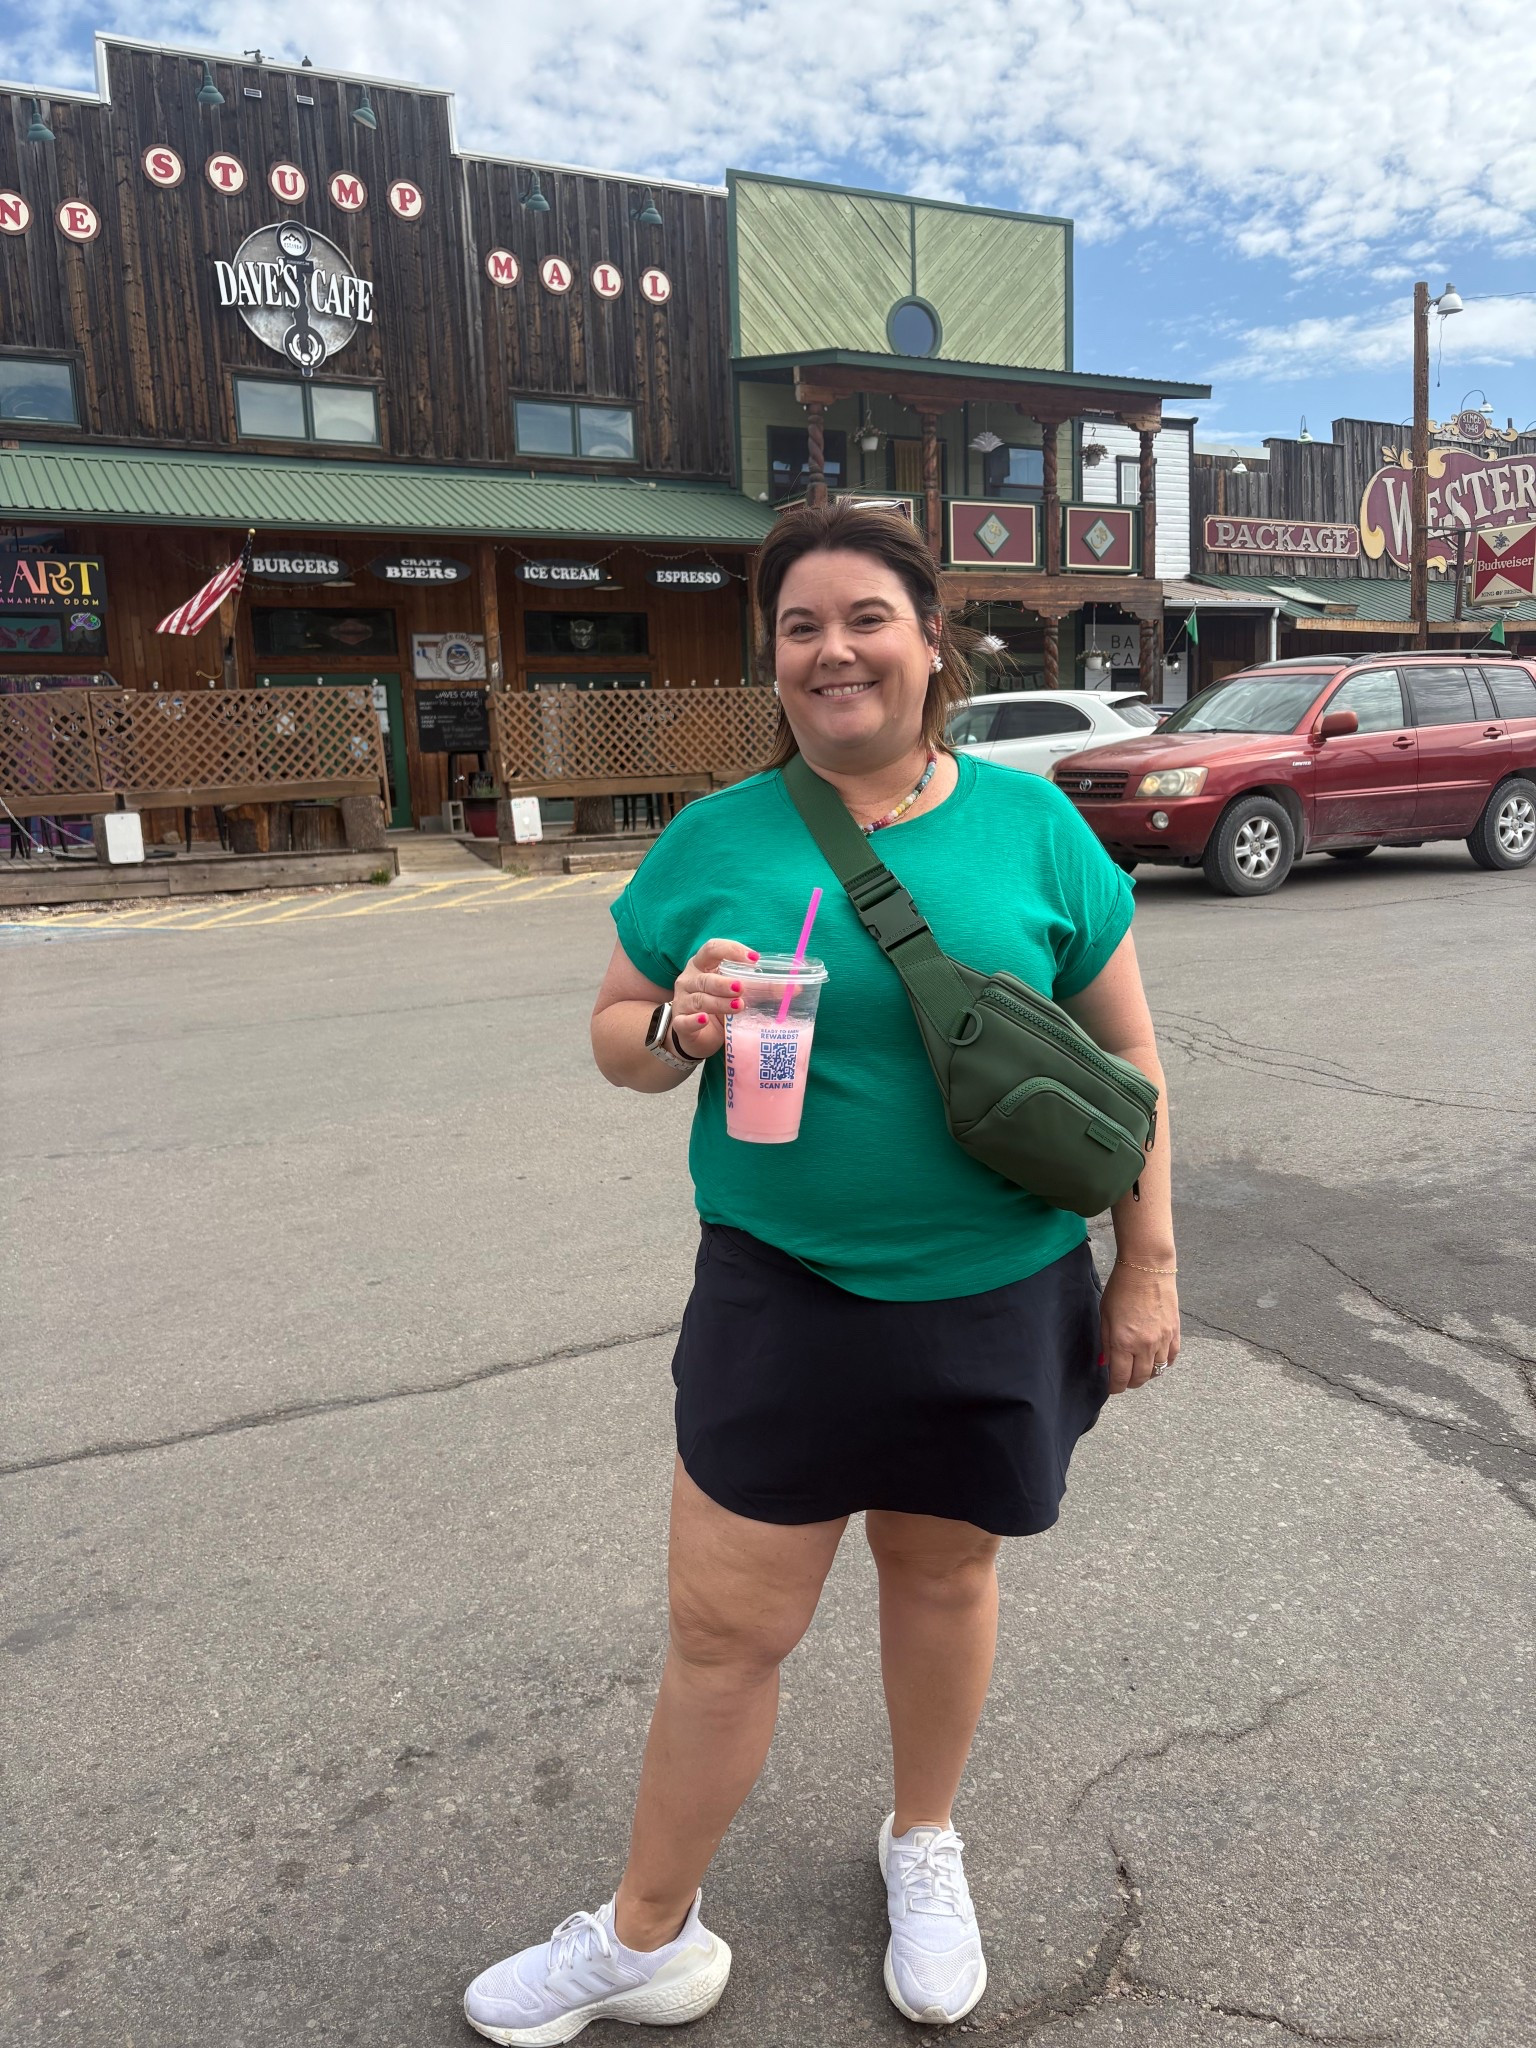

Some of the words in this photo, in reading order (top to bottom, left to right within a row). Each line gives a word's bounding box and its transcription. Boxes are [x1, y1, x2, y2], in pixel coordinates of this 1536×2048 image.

[152, 153, 416, 211] STUMP
[493, 255, 665, 298] MALL
[214, 258, 300, 308] DAVE'S
[311, 269, 373, 323] CAFE
[1462, 413, 1481, 424] SINCE
[1464, 423, 1479, 434] 1948
[1215, 523, 1350, 554] PACKAGE
[252, 558, 339, 574] BURGERS
[401, 559, 442, 567] CRAFT
[1477, 555, 1534, 572] Budweiser
[9, 560, 99, 595] ART
[386, 566, 457, 579] BEERS
[524, 566, 548, 579] ICE
[551, 567, 599, 580] CREAM
[656, 571, 721, 584] ESPRESSO
[63, 598, 99, 606] ODOM
[1111, 653, 1140, 667] CA
[726, 1014, 735, 1064] DUTCH
[727, 1066, 735, 1109] BROS
